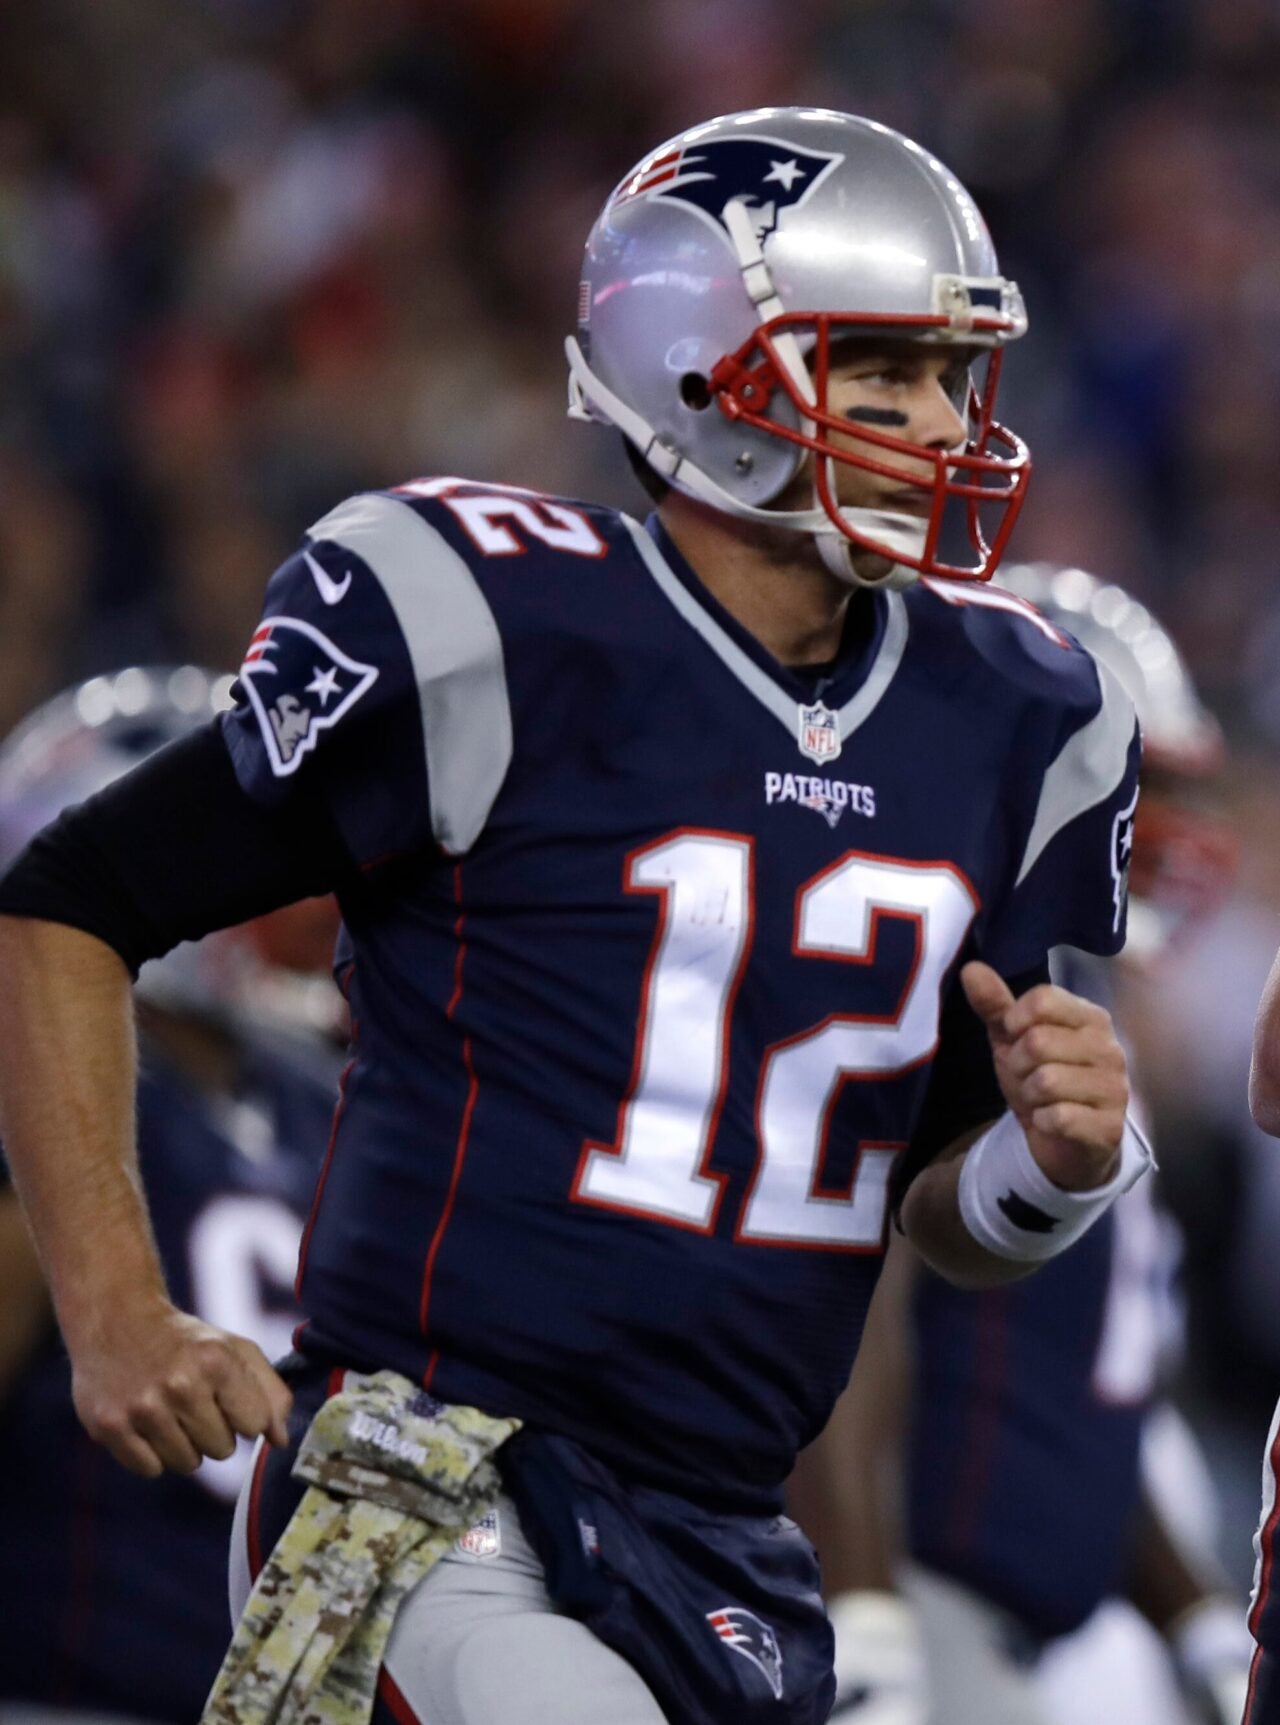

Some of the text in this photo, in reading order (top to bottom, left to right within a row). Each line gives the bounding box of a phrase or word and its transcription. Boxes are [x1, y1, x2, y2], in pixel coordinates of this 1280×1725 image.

[805, 728, 837, 754] NFL
[765, 771, 877, 819] PATRIOTS
[569, 825, 981, 1255] 12
